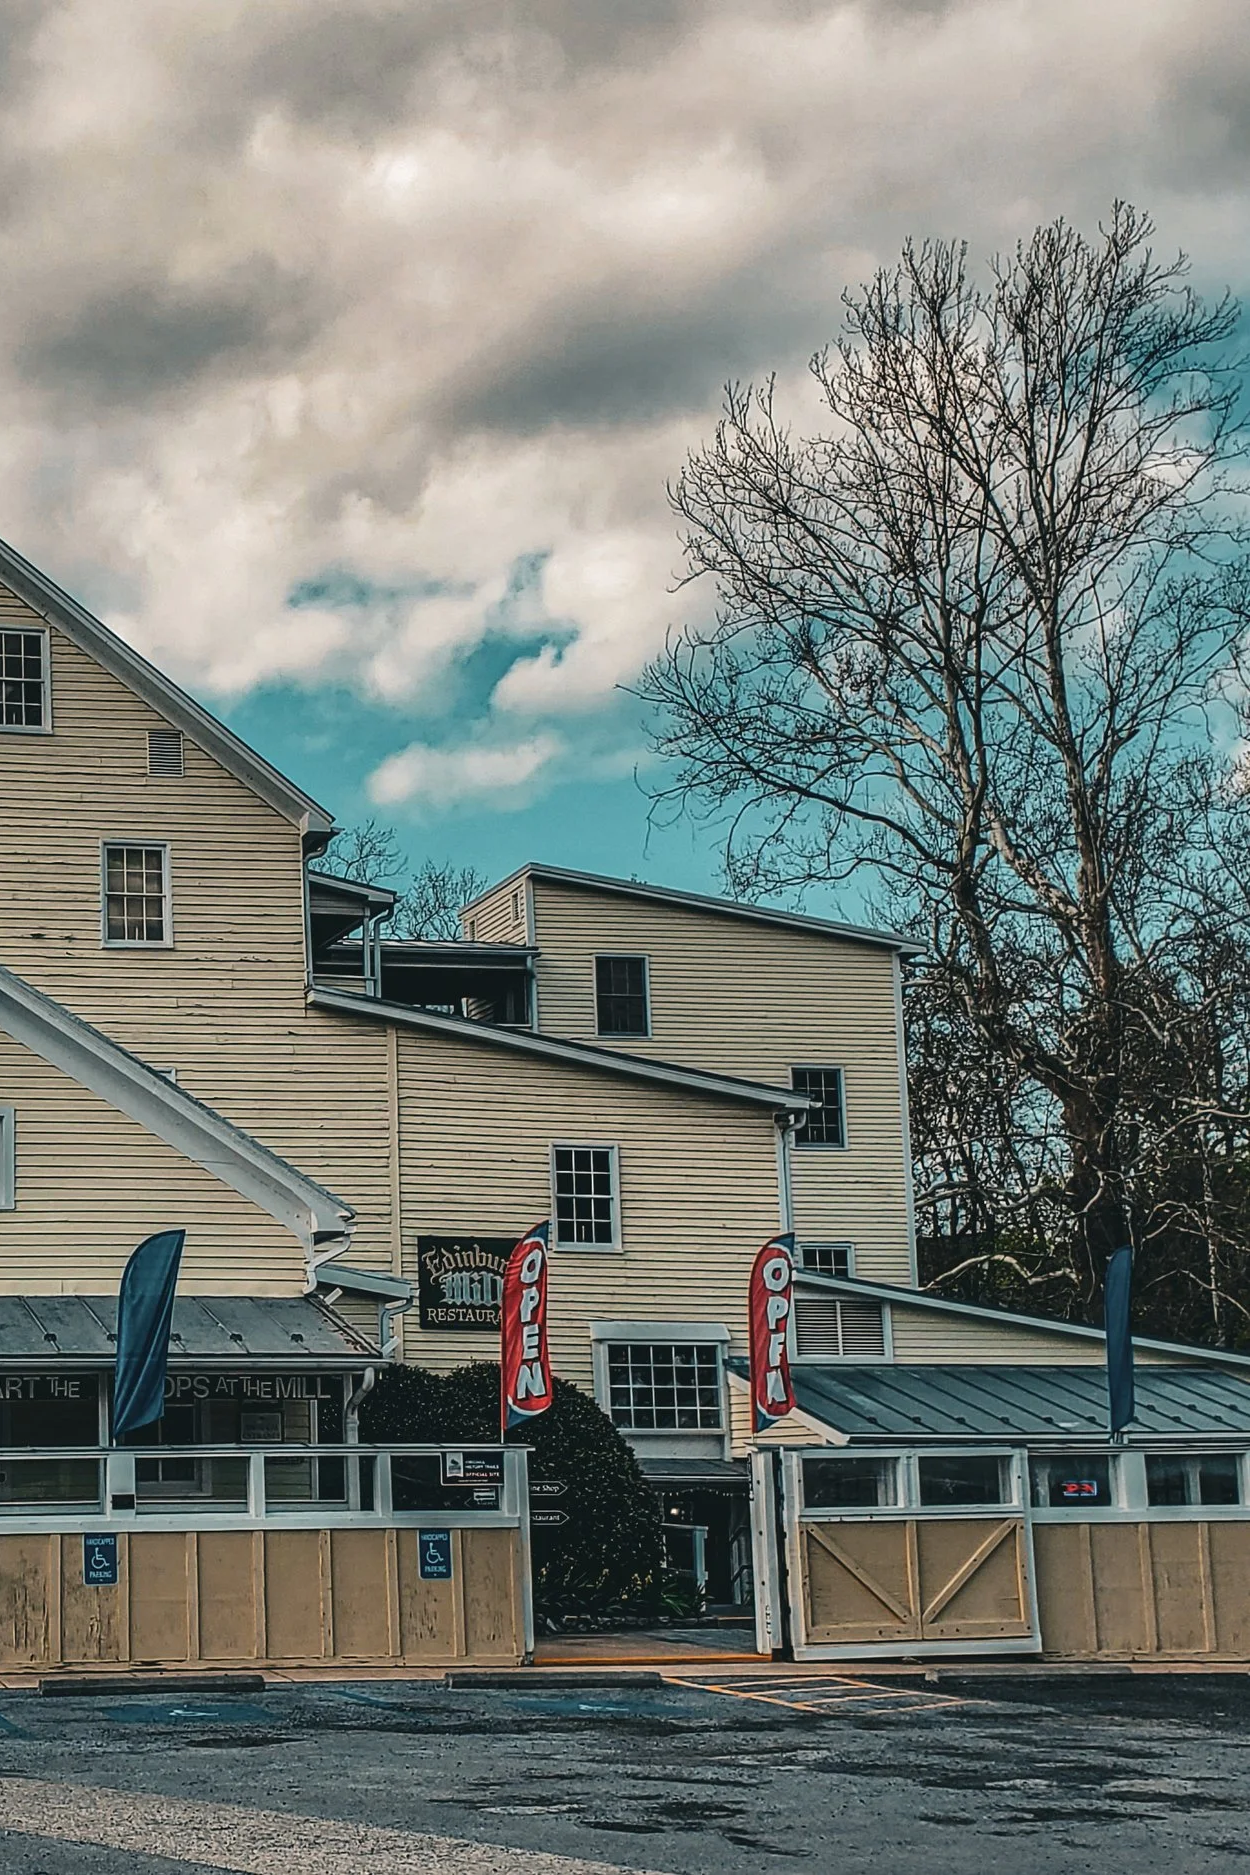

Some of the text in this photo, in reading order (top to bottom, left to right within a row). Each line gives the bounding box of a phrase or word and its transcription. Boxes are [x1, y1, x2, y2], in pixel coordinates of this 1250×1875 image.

[421, 1243, 510, 1286] Edinbur
[426, 1308, 502, 1325] RESTAUR
[517, 1248, 546, 1400] OPEN
[763, 1257, 790, 1405] OPEN
[46, 1376, 80, 1398] THE
[215, 1376, 239, 1396] AT
[239, 1376, 273, 1398] THE
[275, 1376, 332, 1399] MILL
[542, 1484, 560, 1493] Shop
